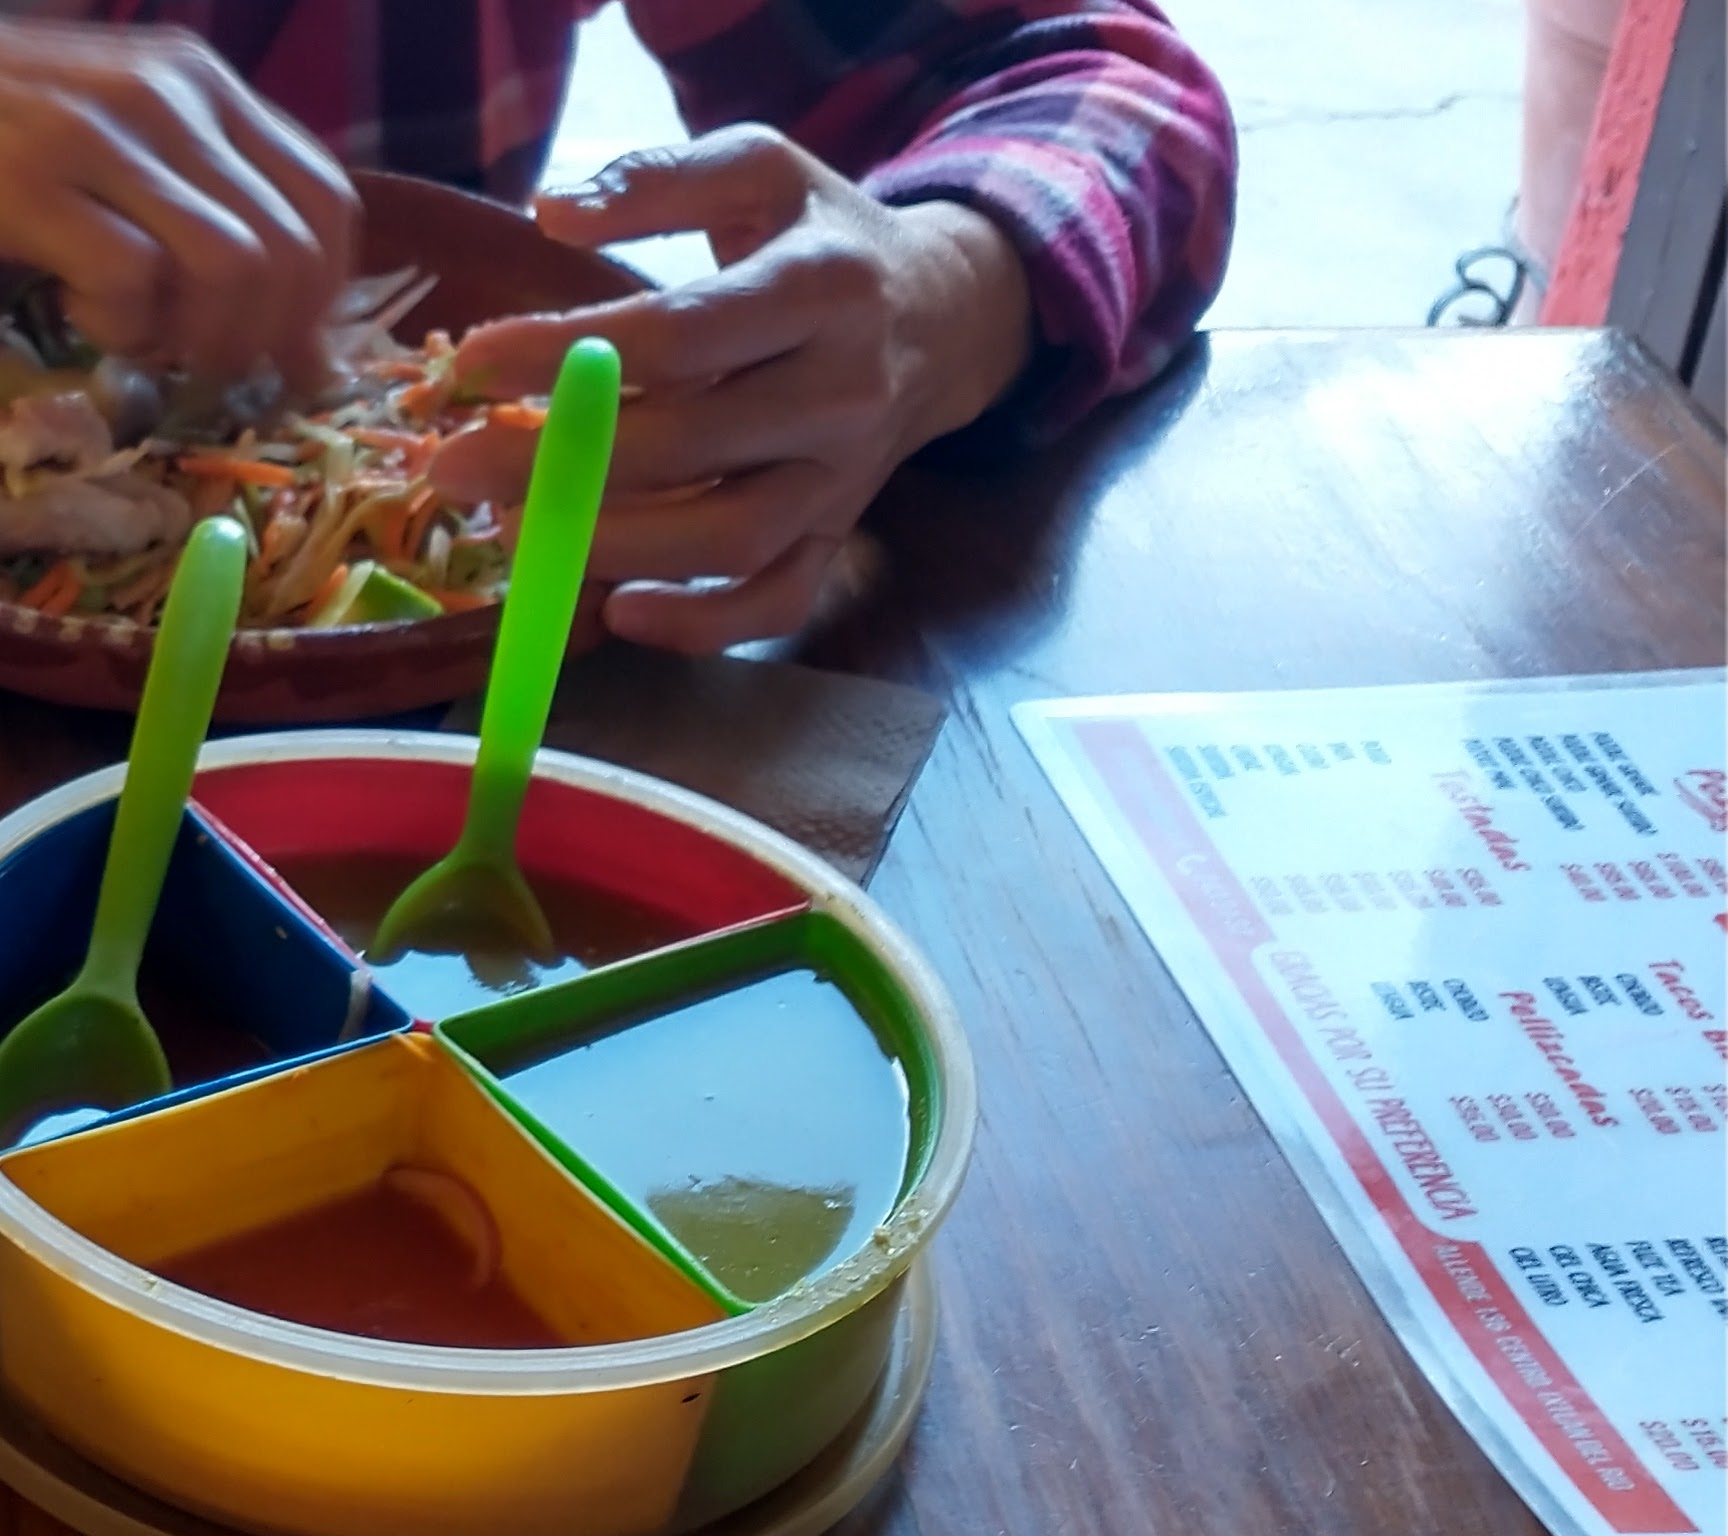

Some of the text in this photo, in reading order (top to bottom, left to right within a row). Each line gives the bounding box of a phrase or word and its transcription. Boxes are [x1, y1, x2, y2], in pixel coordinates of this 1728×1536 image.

[1430, 770, 1532, 872] Tostadas
[1648, 959, 1715, 1020] Tacos
[1346, 1065, 1396, 1091] SU
[1498, 990, 1621, 1128] Pellizcadas
[1366, 1097, 1478, 1221] PREFERENCIA
